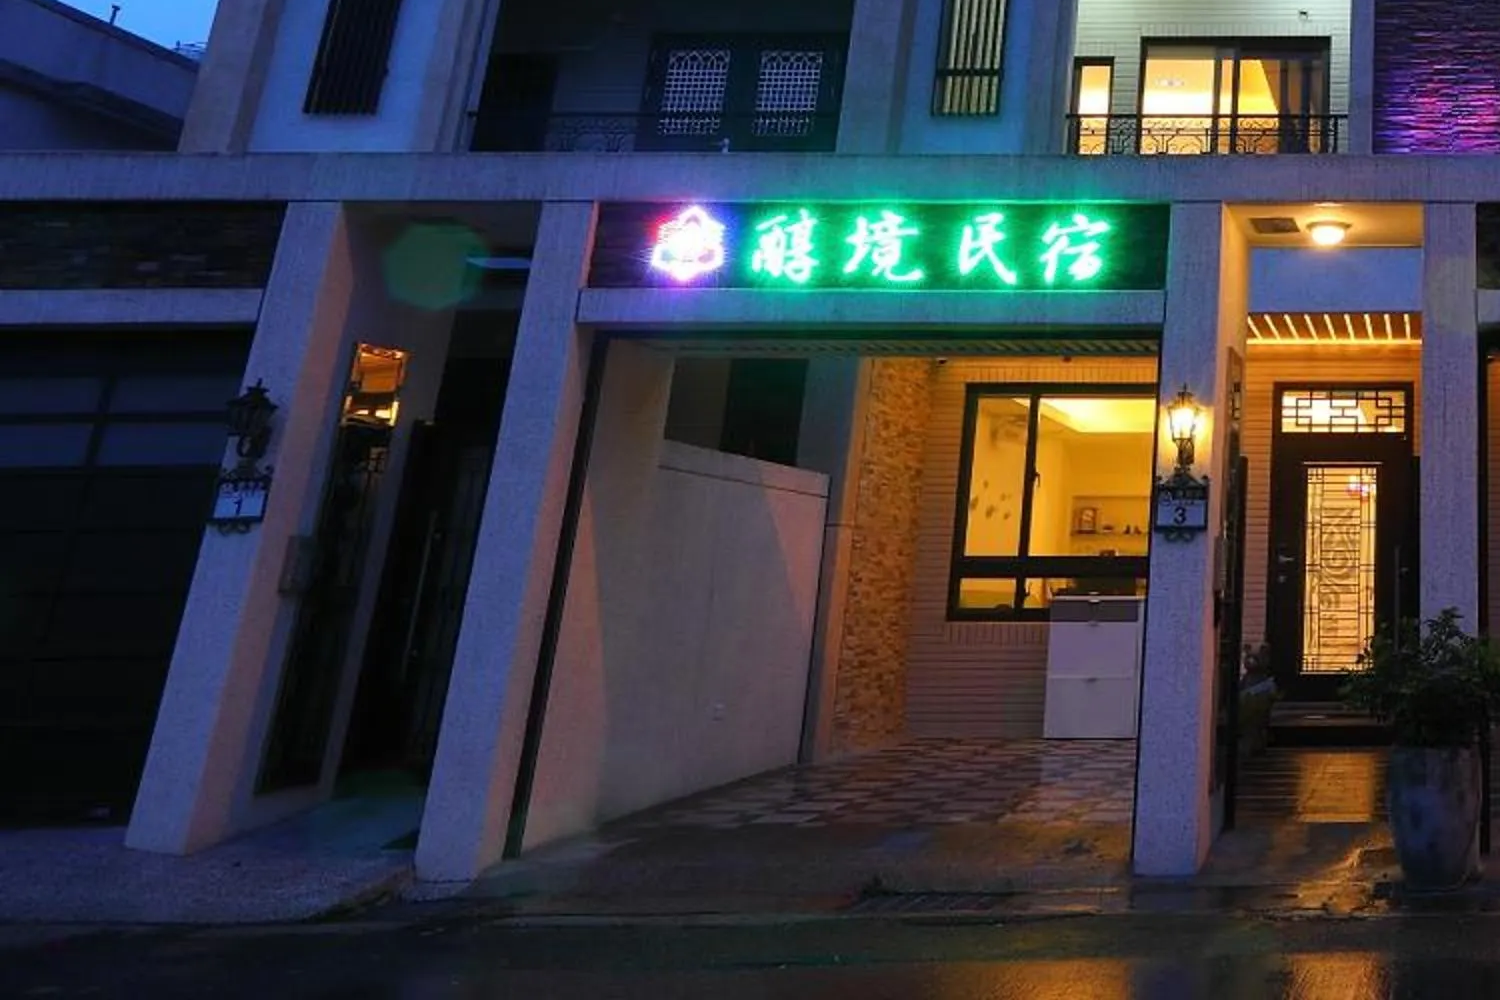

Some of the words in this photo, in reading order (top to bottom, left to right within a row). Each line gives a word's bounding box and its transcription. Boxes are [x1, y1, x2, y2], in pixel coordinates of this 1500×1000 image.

[751, 208, 1110, 284] 醇境民宿
[1174, 506, 1187, 524] 3
